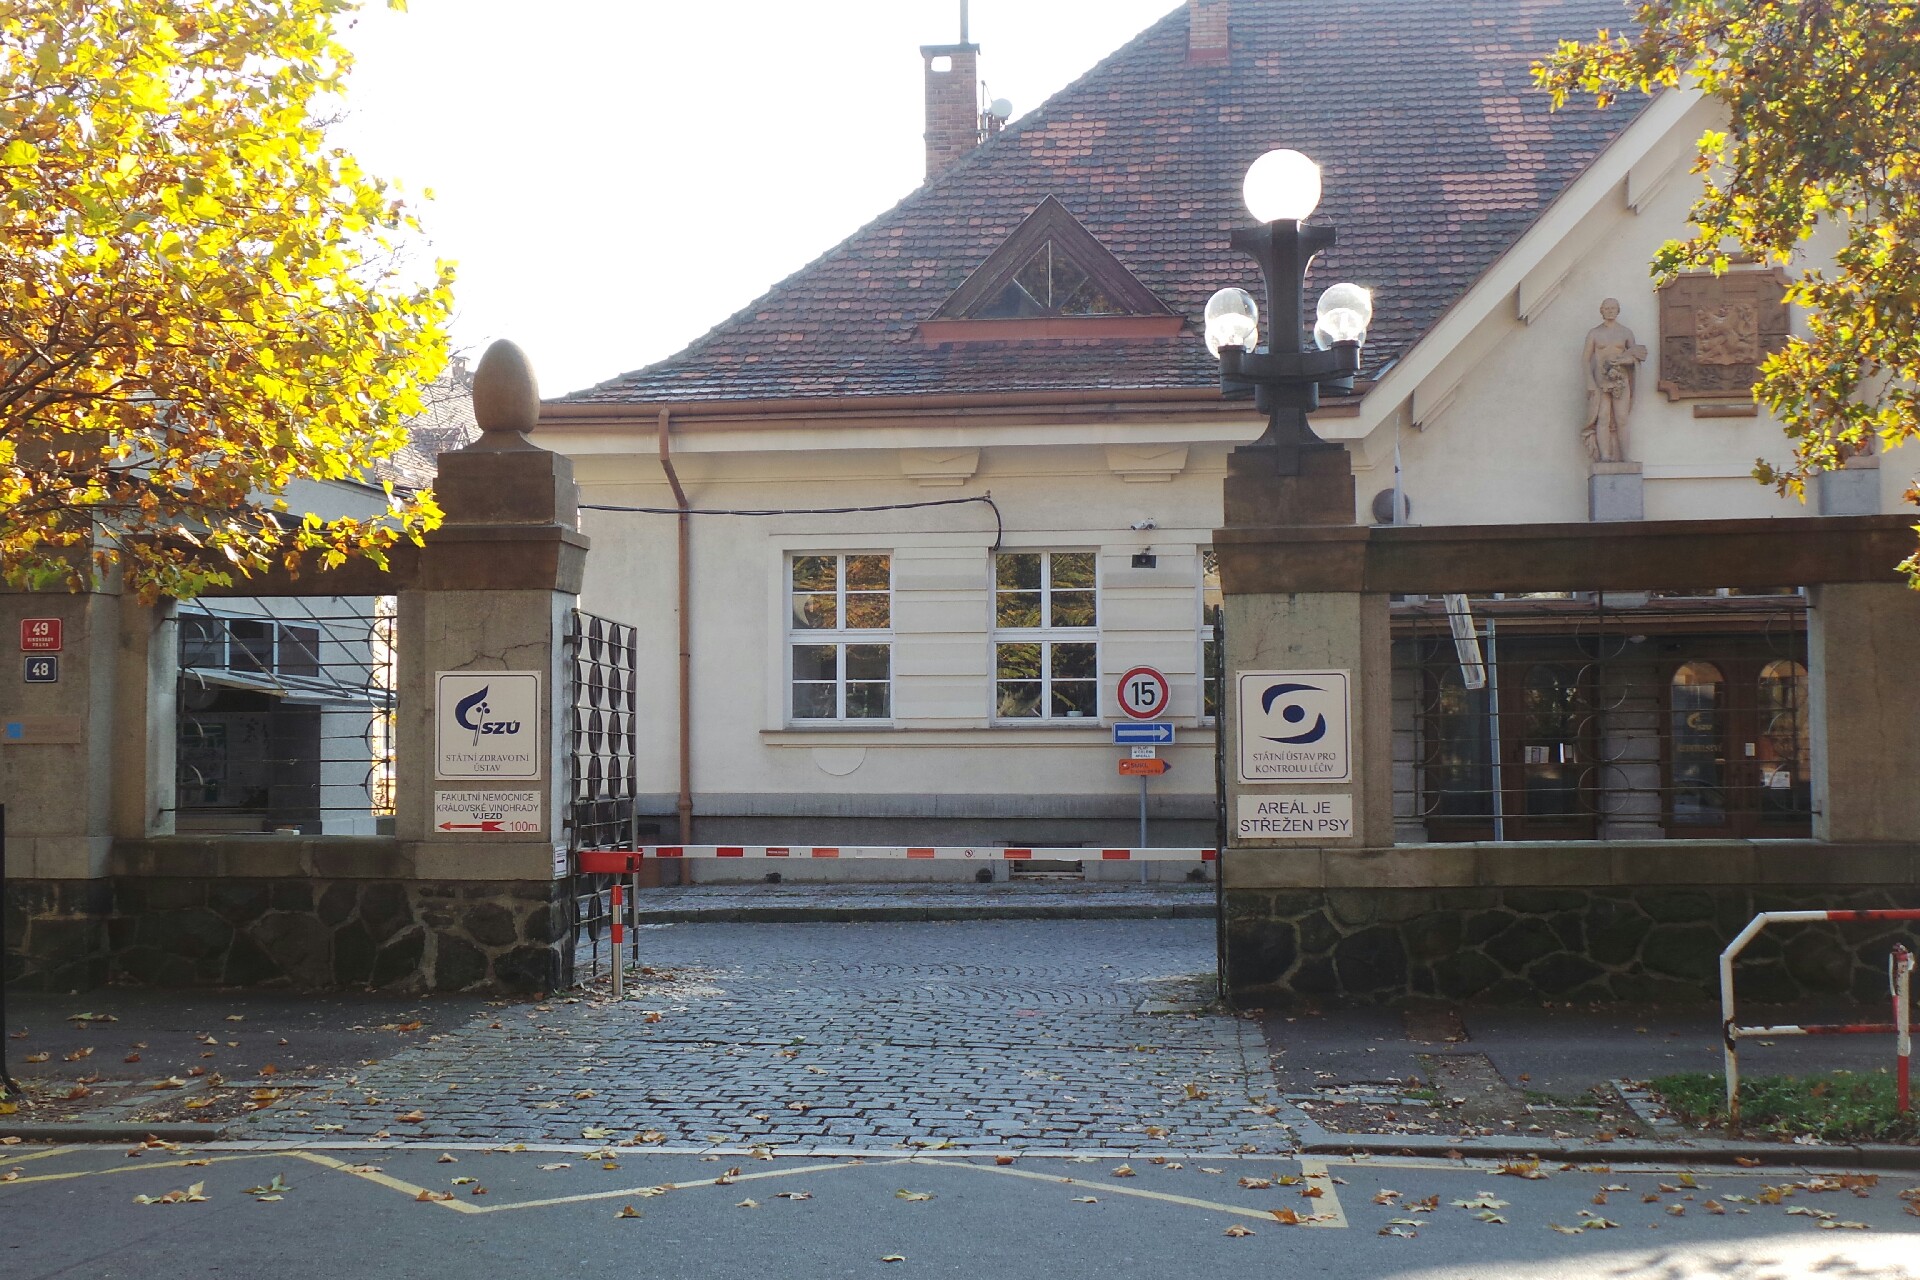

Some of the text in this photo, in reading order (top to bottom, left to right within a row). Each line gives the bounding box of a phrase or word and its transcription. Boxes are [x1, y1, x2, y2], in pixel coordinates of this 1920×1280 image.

[32, 622, 49, 636] 49
[32, 662, 49, 676] 48
[1131, 681, 1156, 706] 15
[481, 719, 521, 735] SZÚ
[446, 753, 529, 762] STÁTNÍ ZDRAVOTNÍ
[1253, 751, 1336, 761] STÁTNÍ ÚSTAV PRO
[473, 763, 501, 772] ÚSTAV
[1255, 763, 1334, 773] KONTROLU LÉČIV
[441, 793, 533, 801] FAKULTNÍ NEMOCNICE
[436, 803, 539, 812] KRÁLOVSKÉ VINOHRADY
[1257, 800, 1331, 814] AREÁL JE
[473, 812, 503, 820] VJEZD
[509, 821, 538, 832] 100m
[1240, 817, 1349, 831] STŘEŽEN PSY
